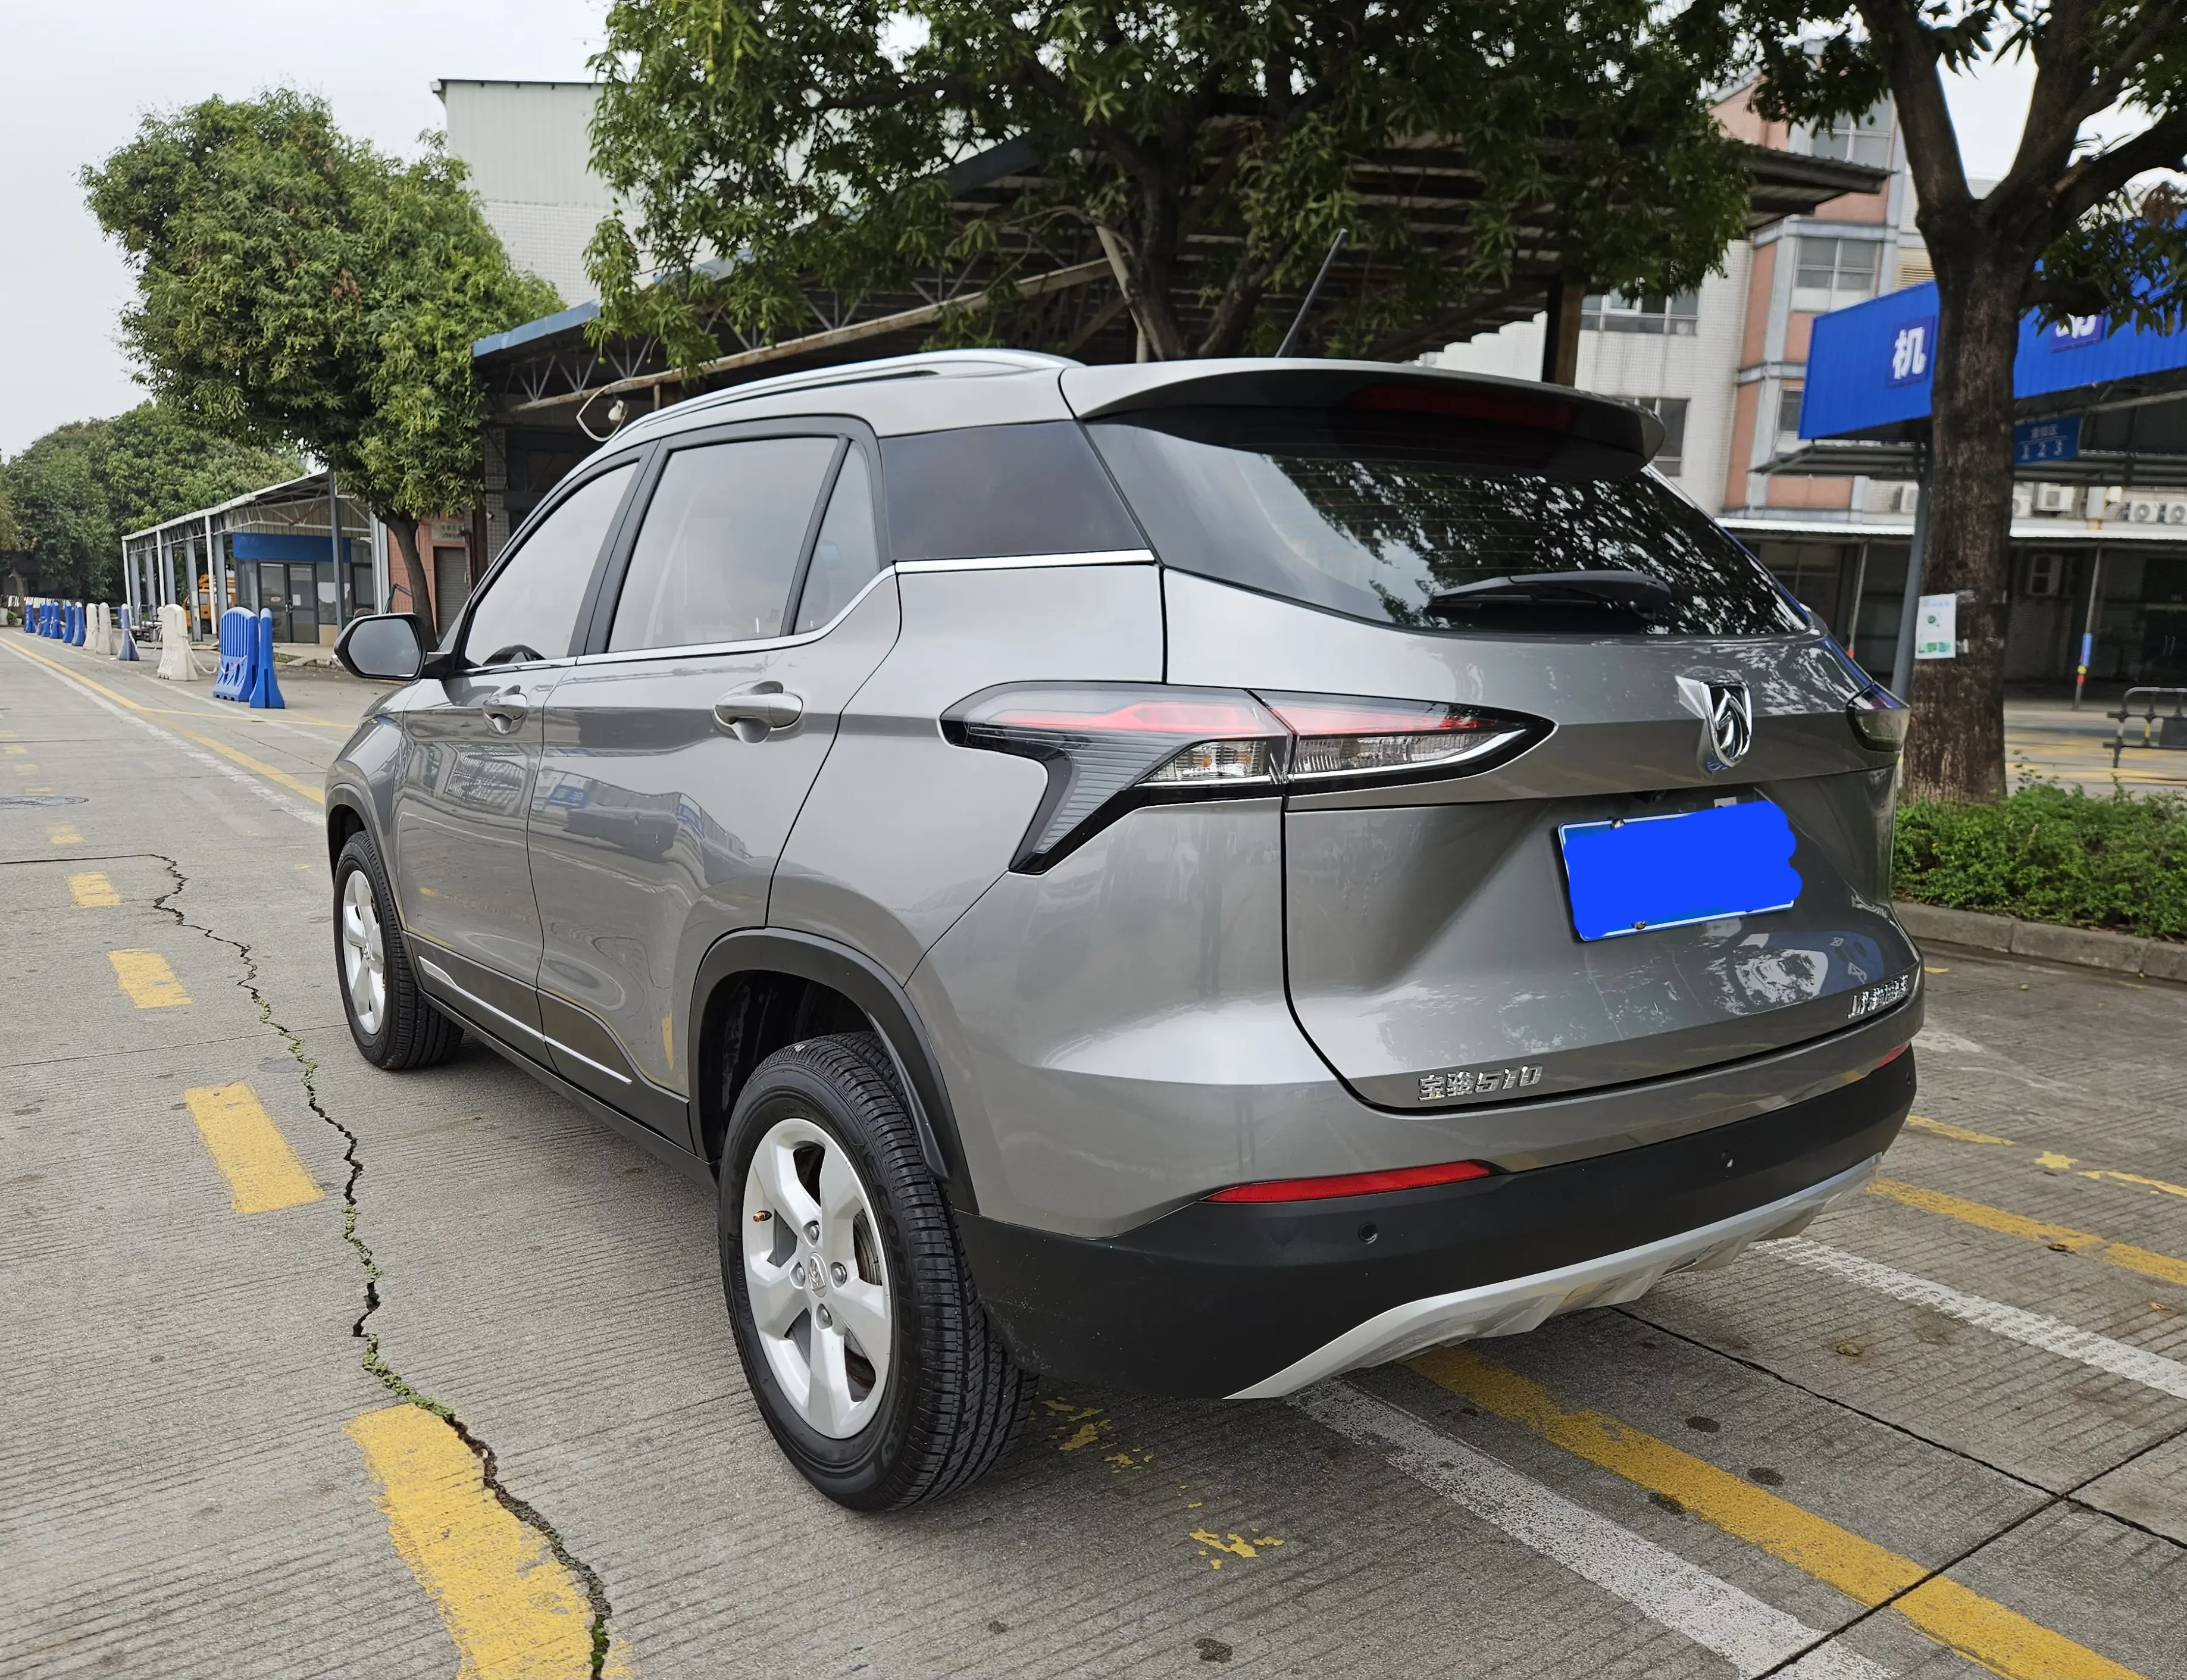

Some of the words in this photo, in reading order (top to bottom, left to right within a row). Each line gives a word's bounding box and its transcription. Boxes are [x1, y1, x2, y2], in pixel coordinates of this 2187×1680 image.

[1892, 326, 1926, 380] 机
[2037, 442, 2047, 458] 2
[2054, 439, 2063, 456] 3
[1418, 1063, 1543, 1102] 宝骏510
